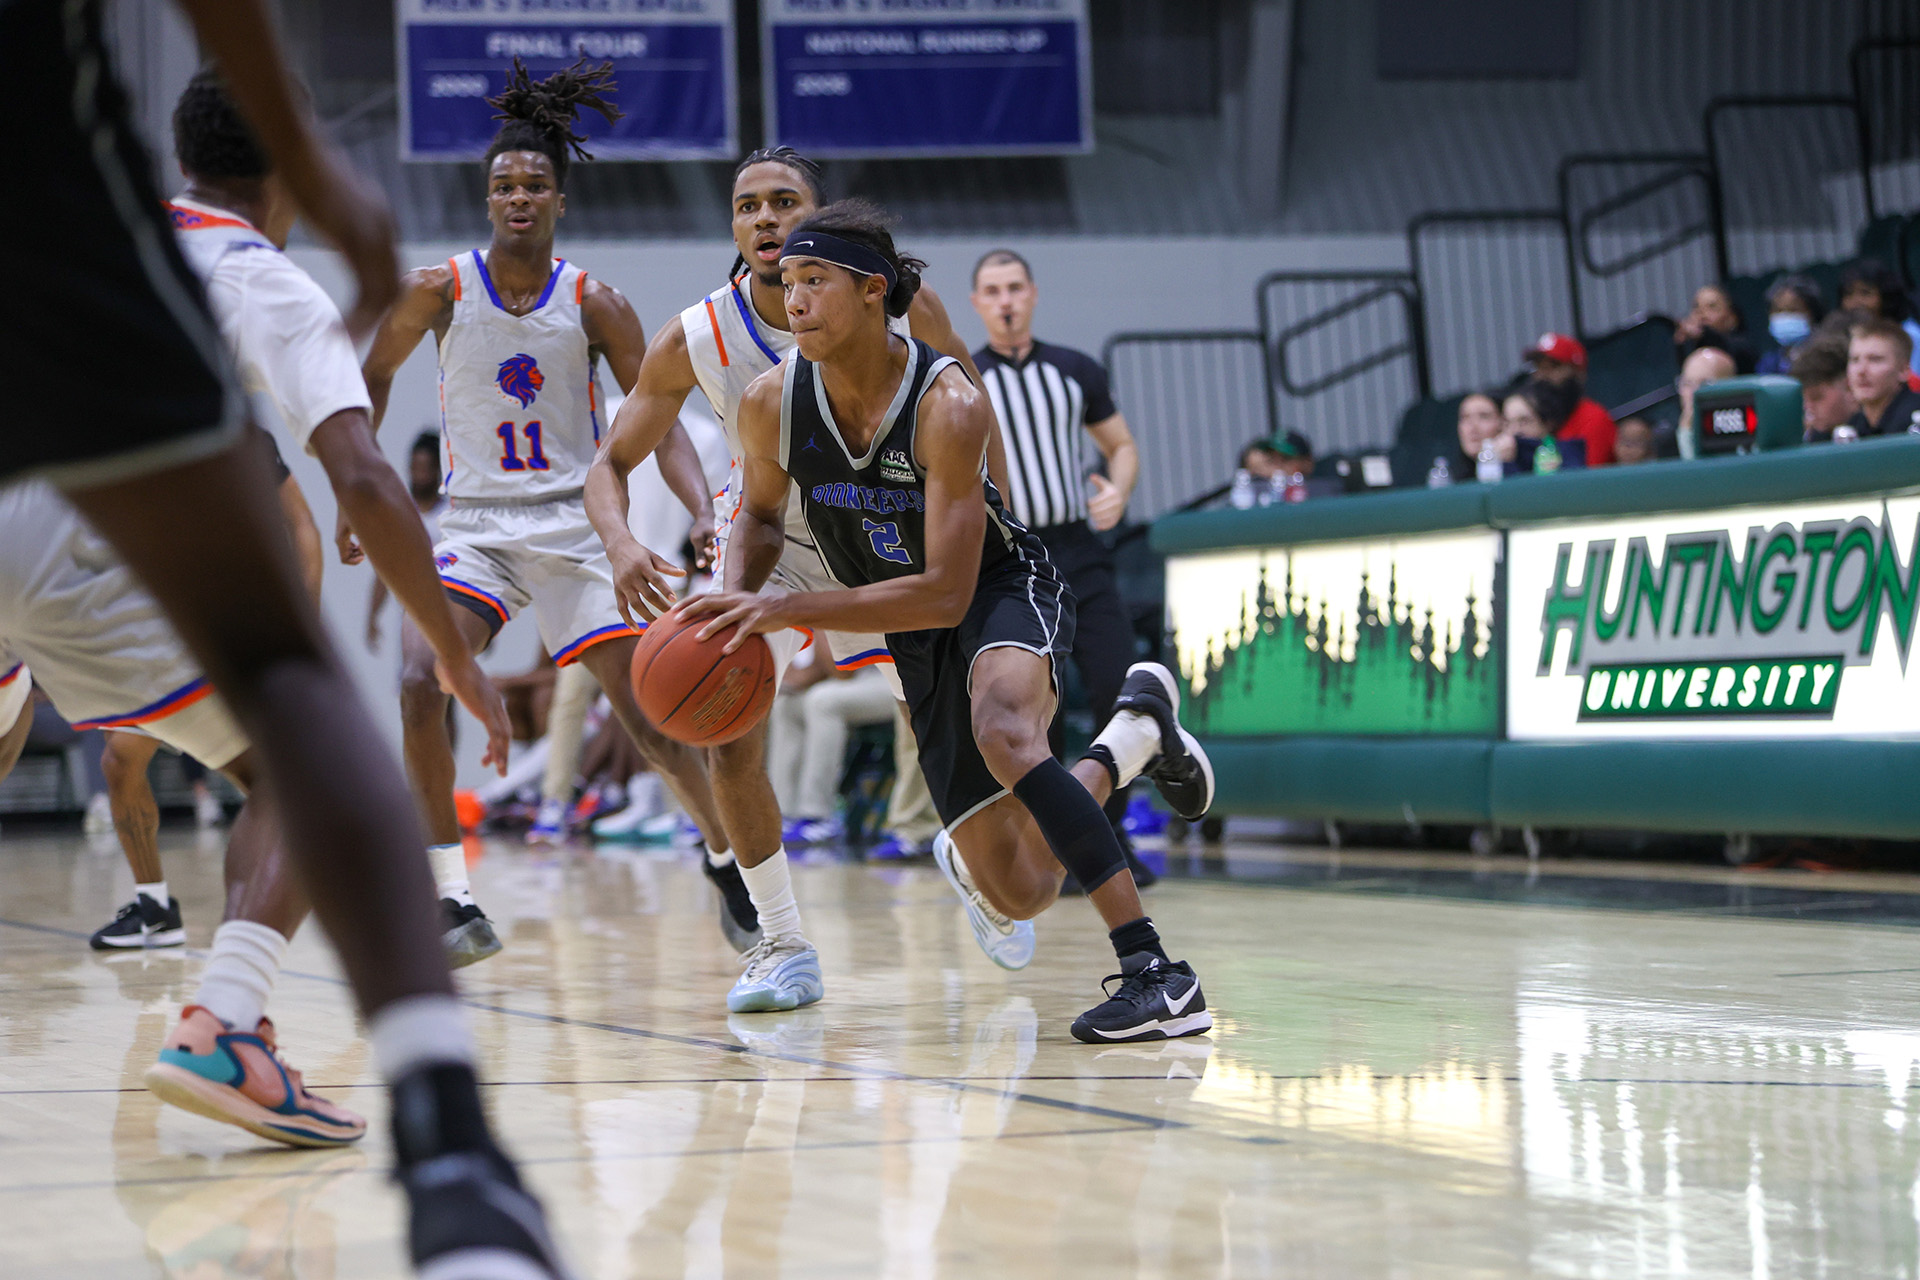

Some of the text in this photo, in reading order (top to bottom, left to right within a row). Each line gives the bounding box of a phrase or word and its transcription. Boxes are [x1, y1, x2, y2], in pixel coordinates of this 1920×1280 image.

[488, 33, 648, 57] FINAL FOUR
[805, 31, 915, 54] NATIONAL
[496, 420, 550, 472] 11
[811, 482, 926, 515] PIONEERS
[862, 517, 914, 565] 2
[1538, 505, 1920, 672] HUNTINGTON
[1585, 663, 1835, 711] UNIVERSITY
